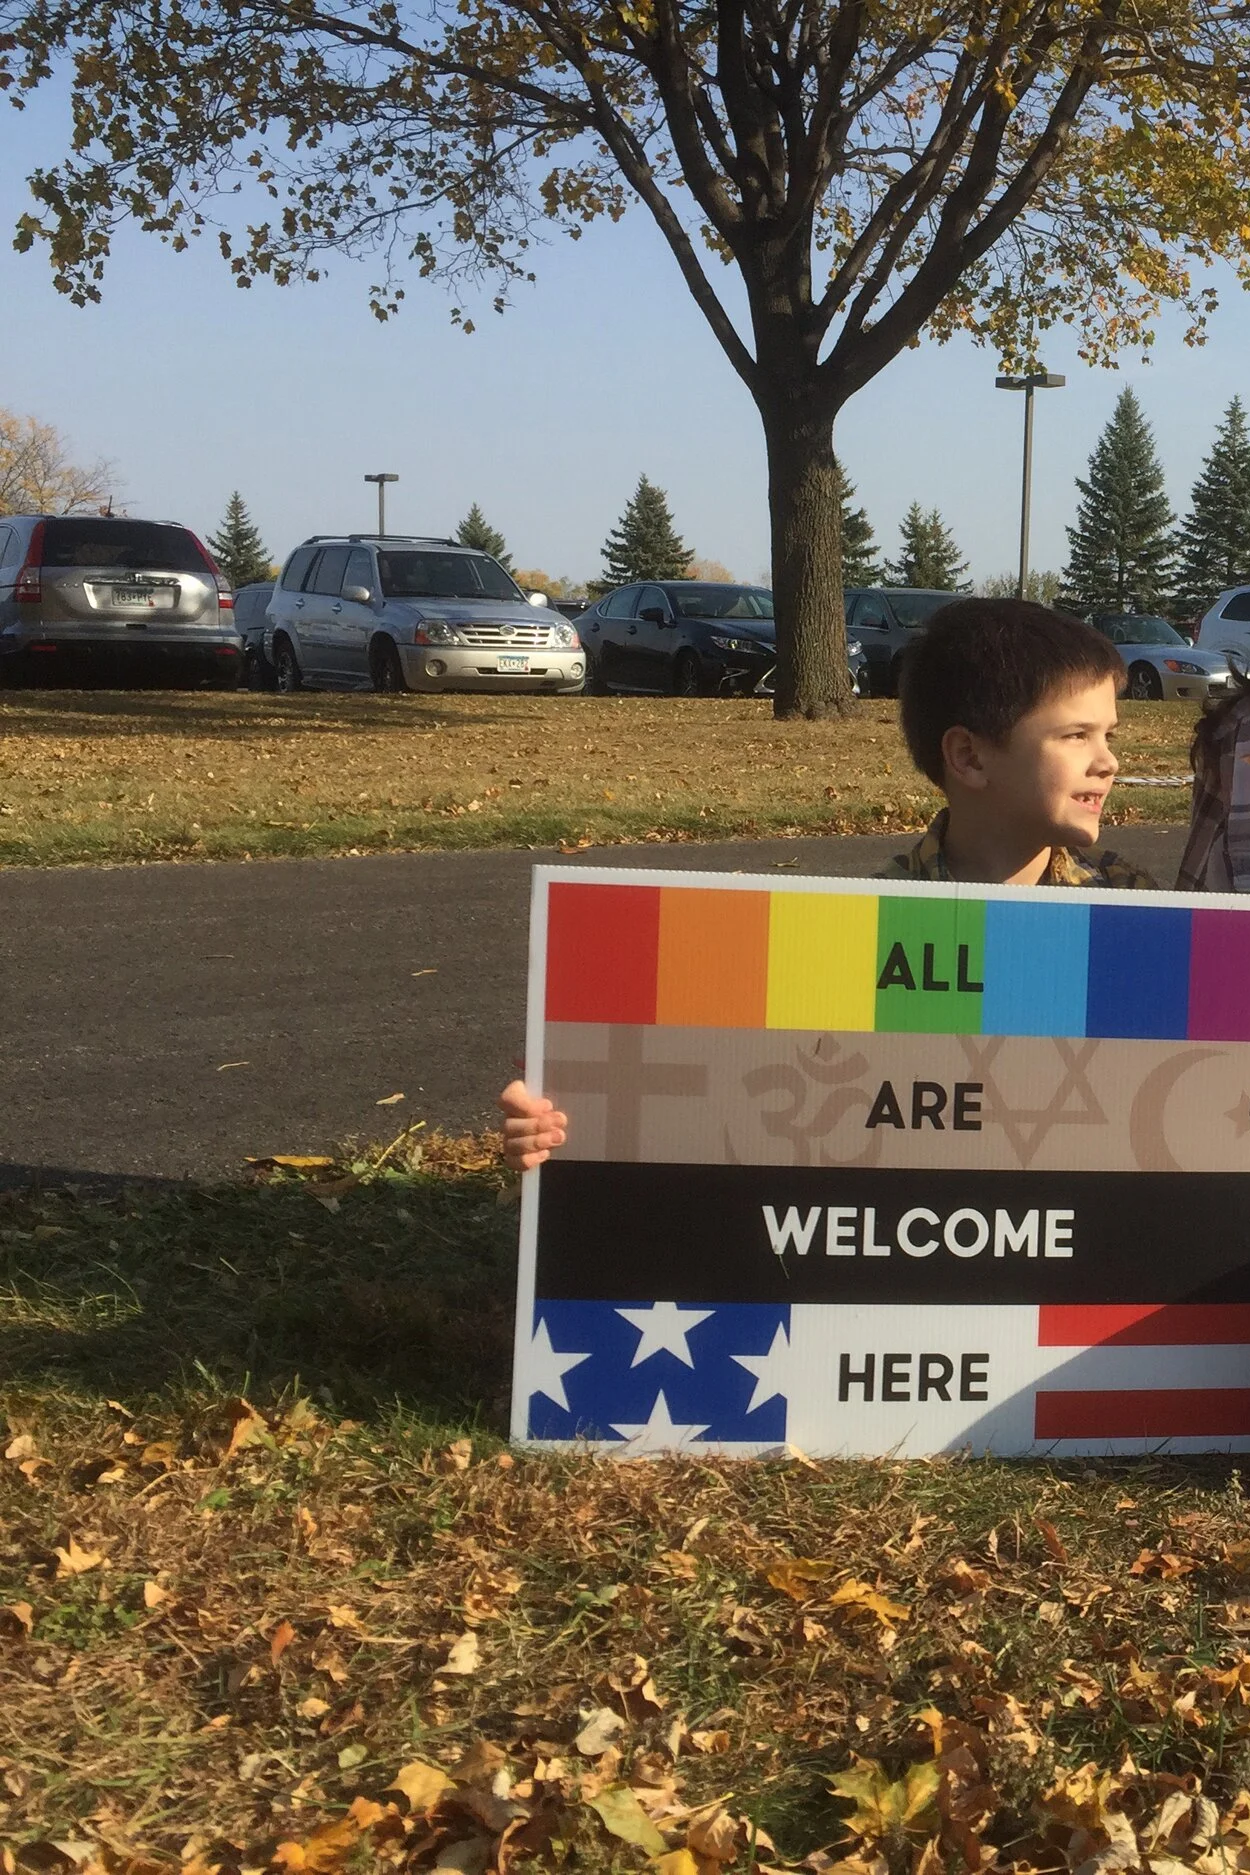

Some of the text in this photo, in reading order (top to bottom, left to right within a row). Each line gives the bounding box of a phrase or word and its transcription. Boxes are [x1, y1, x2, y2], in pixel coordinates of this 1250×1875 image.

[877, 942, 985, 993] ALL
[866, 1081, 985, 1131] ARE
[762, 1205, 1076, 1258] WELCOME
[838, 1353, 990, 1402] HERE
